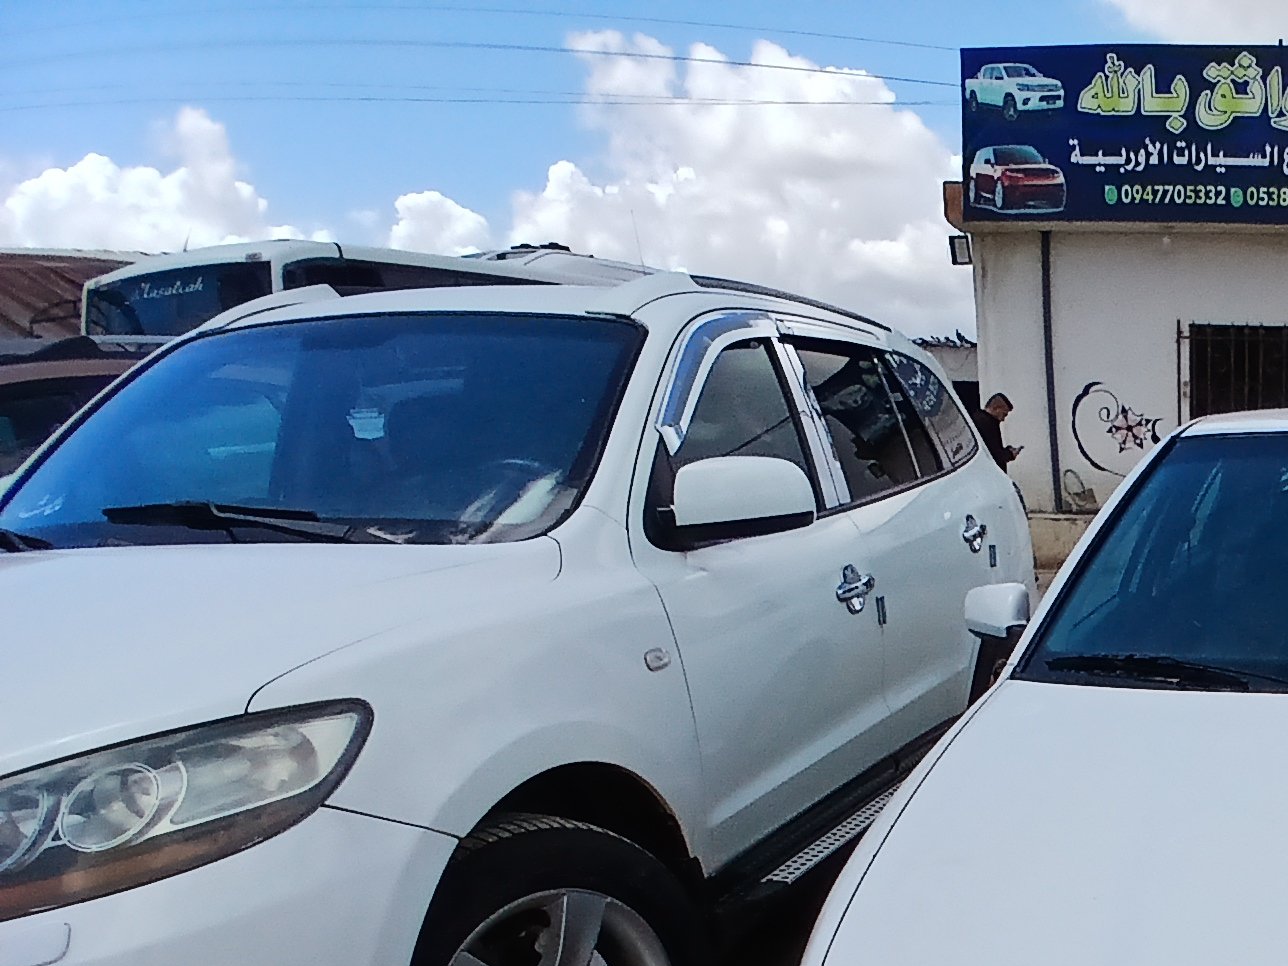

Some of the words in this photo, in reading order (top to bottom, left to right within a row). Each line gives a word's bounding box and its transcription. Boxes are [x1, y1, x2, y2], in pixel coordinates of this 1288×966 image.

[1077, 53, 1190, 134] بالله
[1068, 137, 1168, 174] الأوربية
[1172, 140, 1279, 174] السيارات
[1120, 184, 1227, 205] 0947705332
